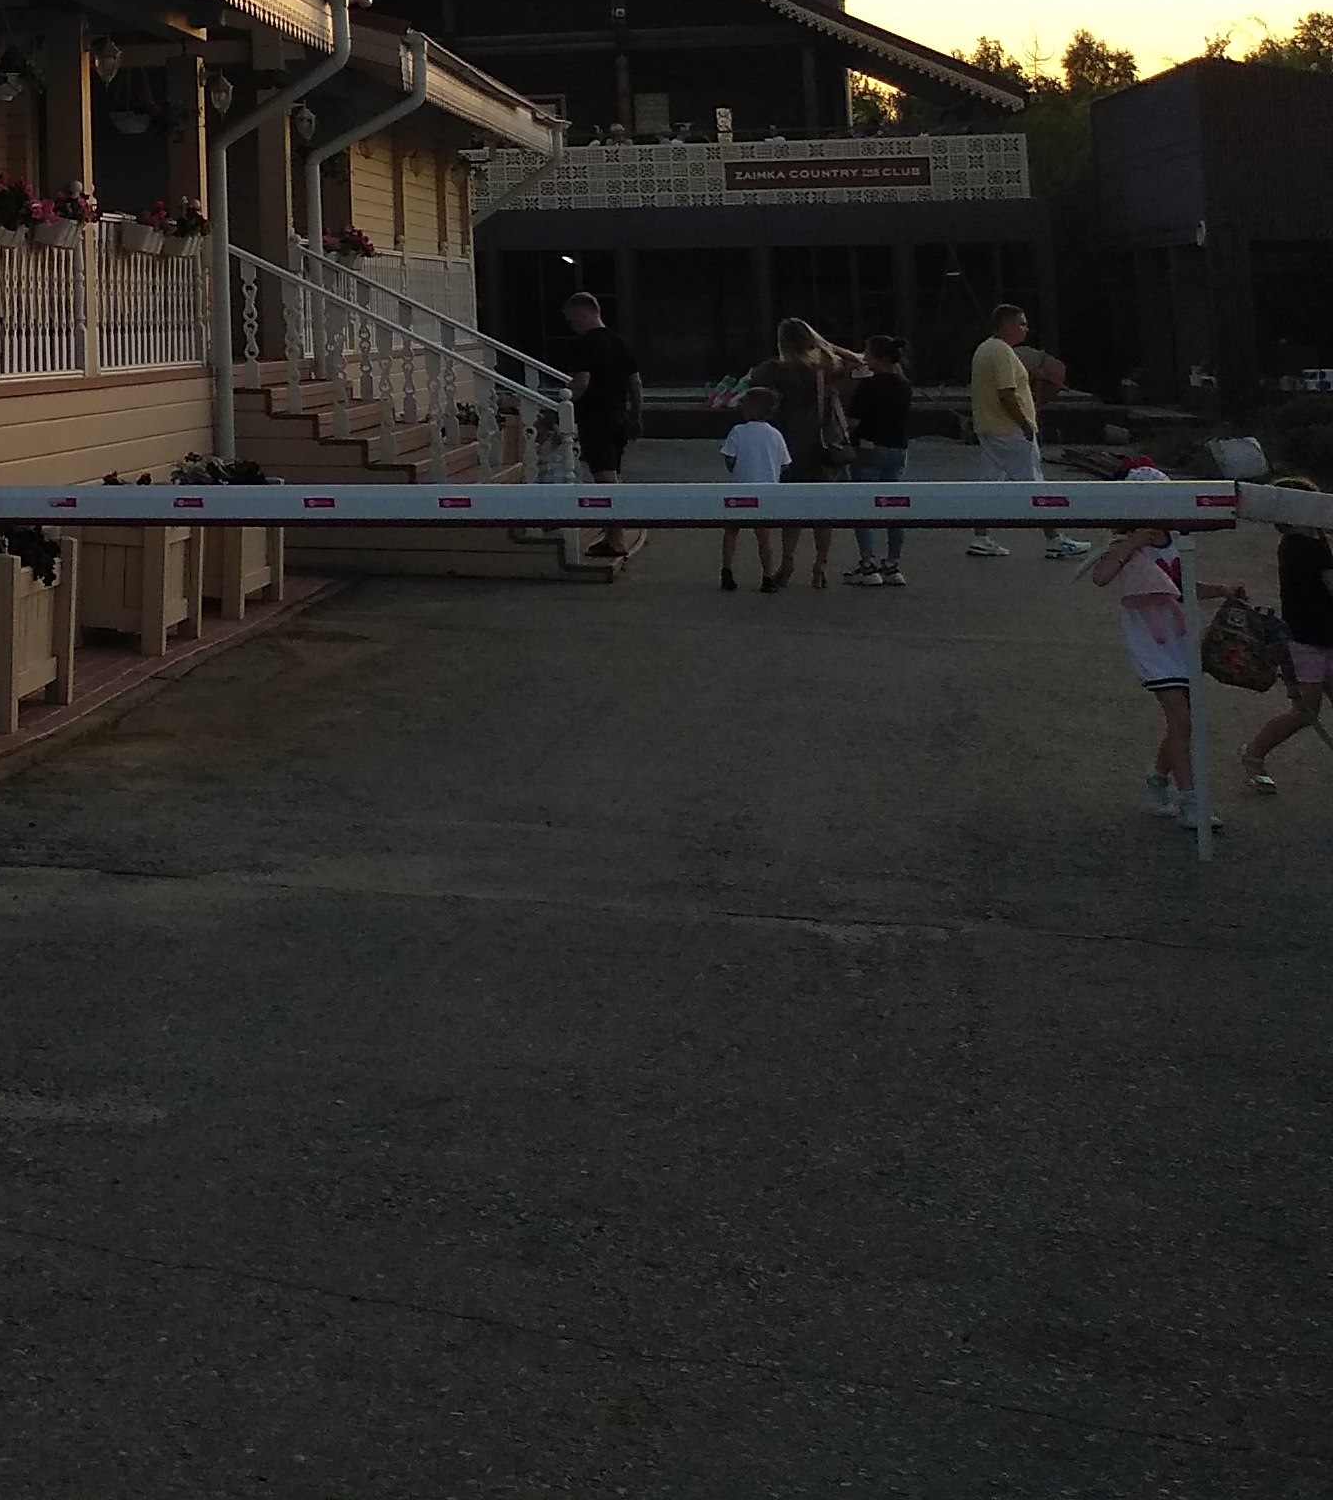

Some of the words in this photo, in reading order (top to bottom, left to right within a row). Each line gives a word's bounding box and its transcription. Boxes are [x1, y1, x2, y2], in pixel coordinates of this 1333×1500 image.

[734, 171, 785, 180] ZAIMKA
[789, 169, 858, 178] COUNTRY
[882, 167, 921, 176] CLUB
